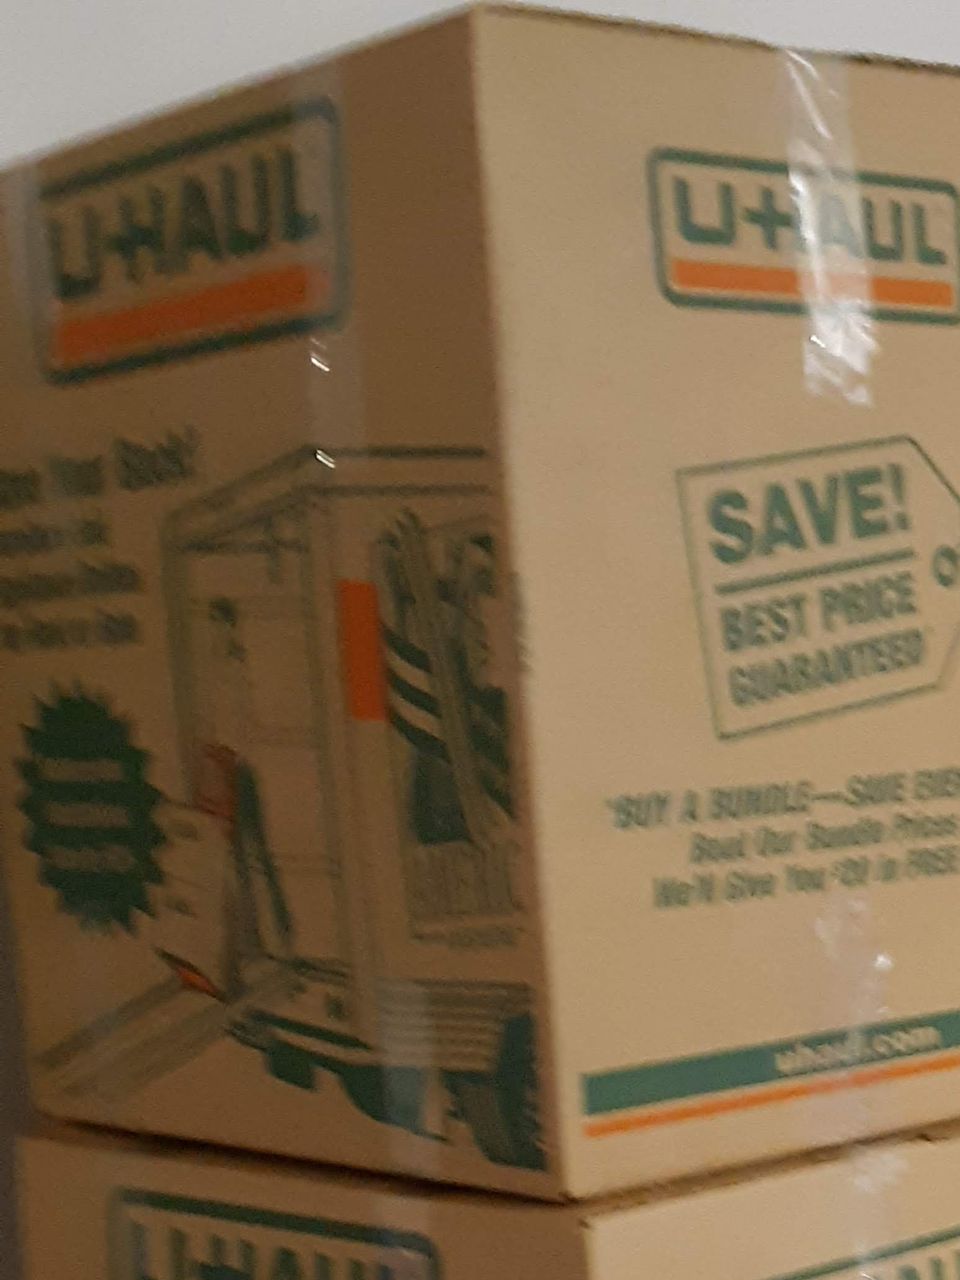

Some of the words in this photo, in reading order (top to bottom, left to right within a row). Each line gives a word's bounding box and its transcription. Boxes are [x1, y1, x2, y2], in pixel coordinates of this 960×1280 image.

[707, 463, 910, 565] SAVE!
[720, 596, 810, 652] BEST
[820, 571, 918, 632] PRICE
